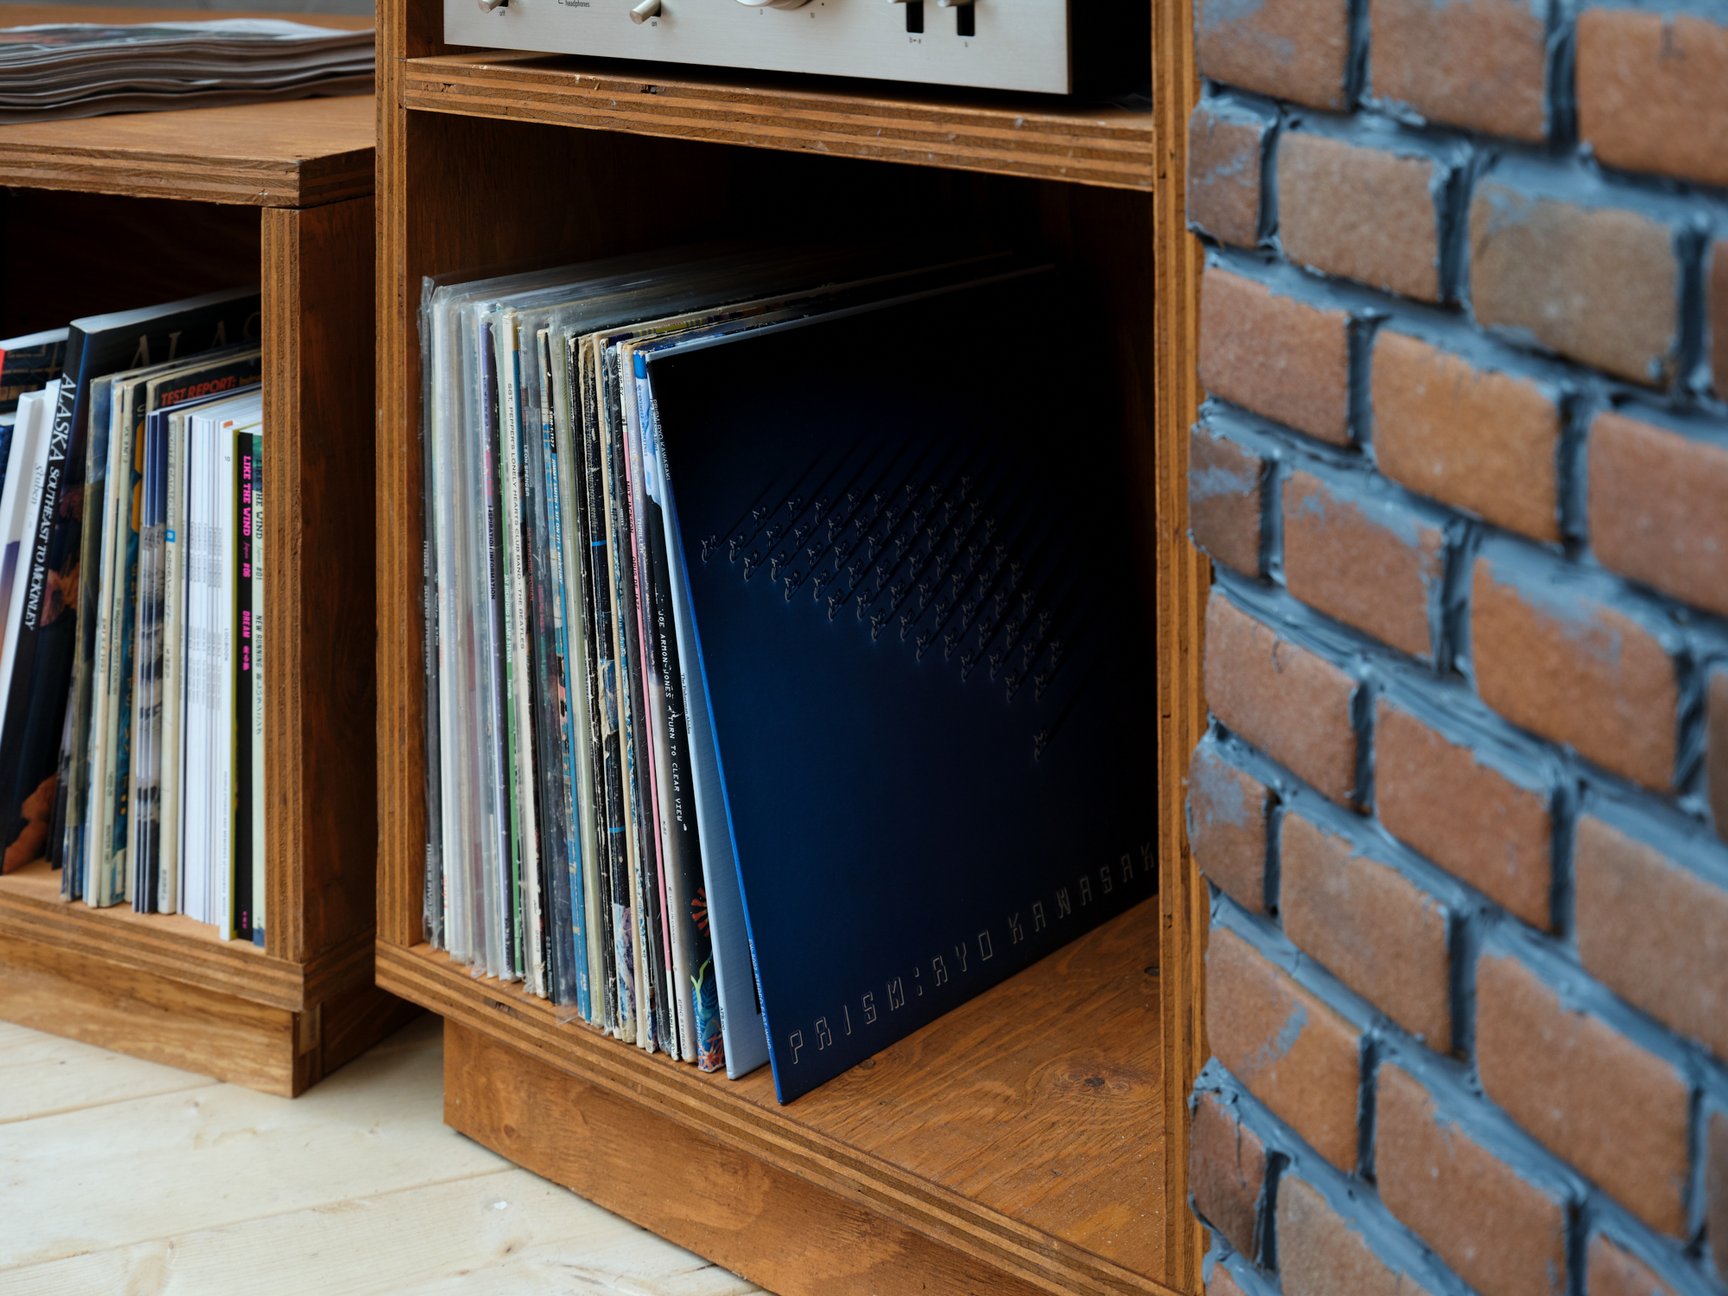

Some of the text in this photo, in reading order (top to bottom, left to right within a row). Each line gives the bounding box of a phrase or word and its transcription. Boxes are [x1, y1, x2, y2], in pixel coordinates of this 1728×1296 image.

[565, 0, 590, 8] headphones
[161, 388, 187, 407] TEST
[187, 375, 237, 400] REPORT:
[49, 372, 76, 460] ALASKA
[653, 399, 661, 421] PRISM
[660, 441, 671, 481] KAWASAKI
[243, 456, 252, 480] LIKE
[39, 467, 60, 543] SOUTHEAST
[243, 483, 252, 504] THE
[243, 508, 251, 537] WIND
[255, 511, 263, 540] WIND
[637, 518, 645, 553] THRILLER
[34, 545, 48, 562] TO
[255, 566, 263, 580] #01
[242, 610, 251, 638] DREAM
[660, 633, 672, 698] ARMON-JONES
[667, 716, 683, 822] TURN TO CLEAR VIEW
[1007, 842, 1155, 944] KAWASAK
[754, 973, 763, 1003] STEREO
[679, 1019, 687, 1050] STEREO
